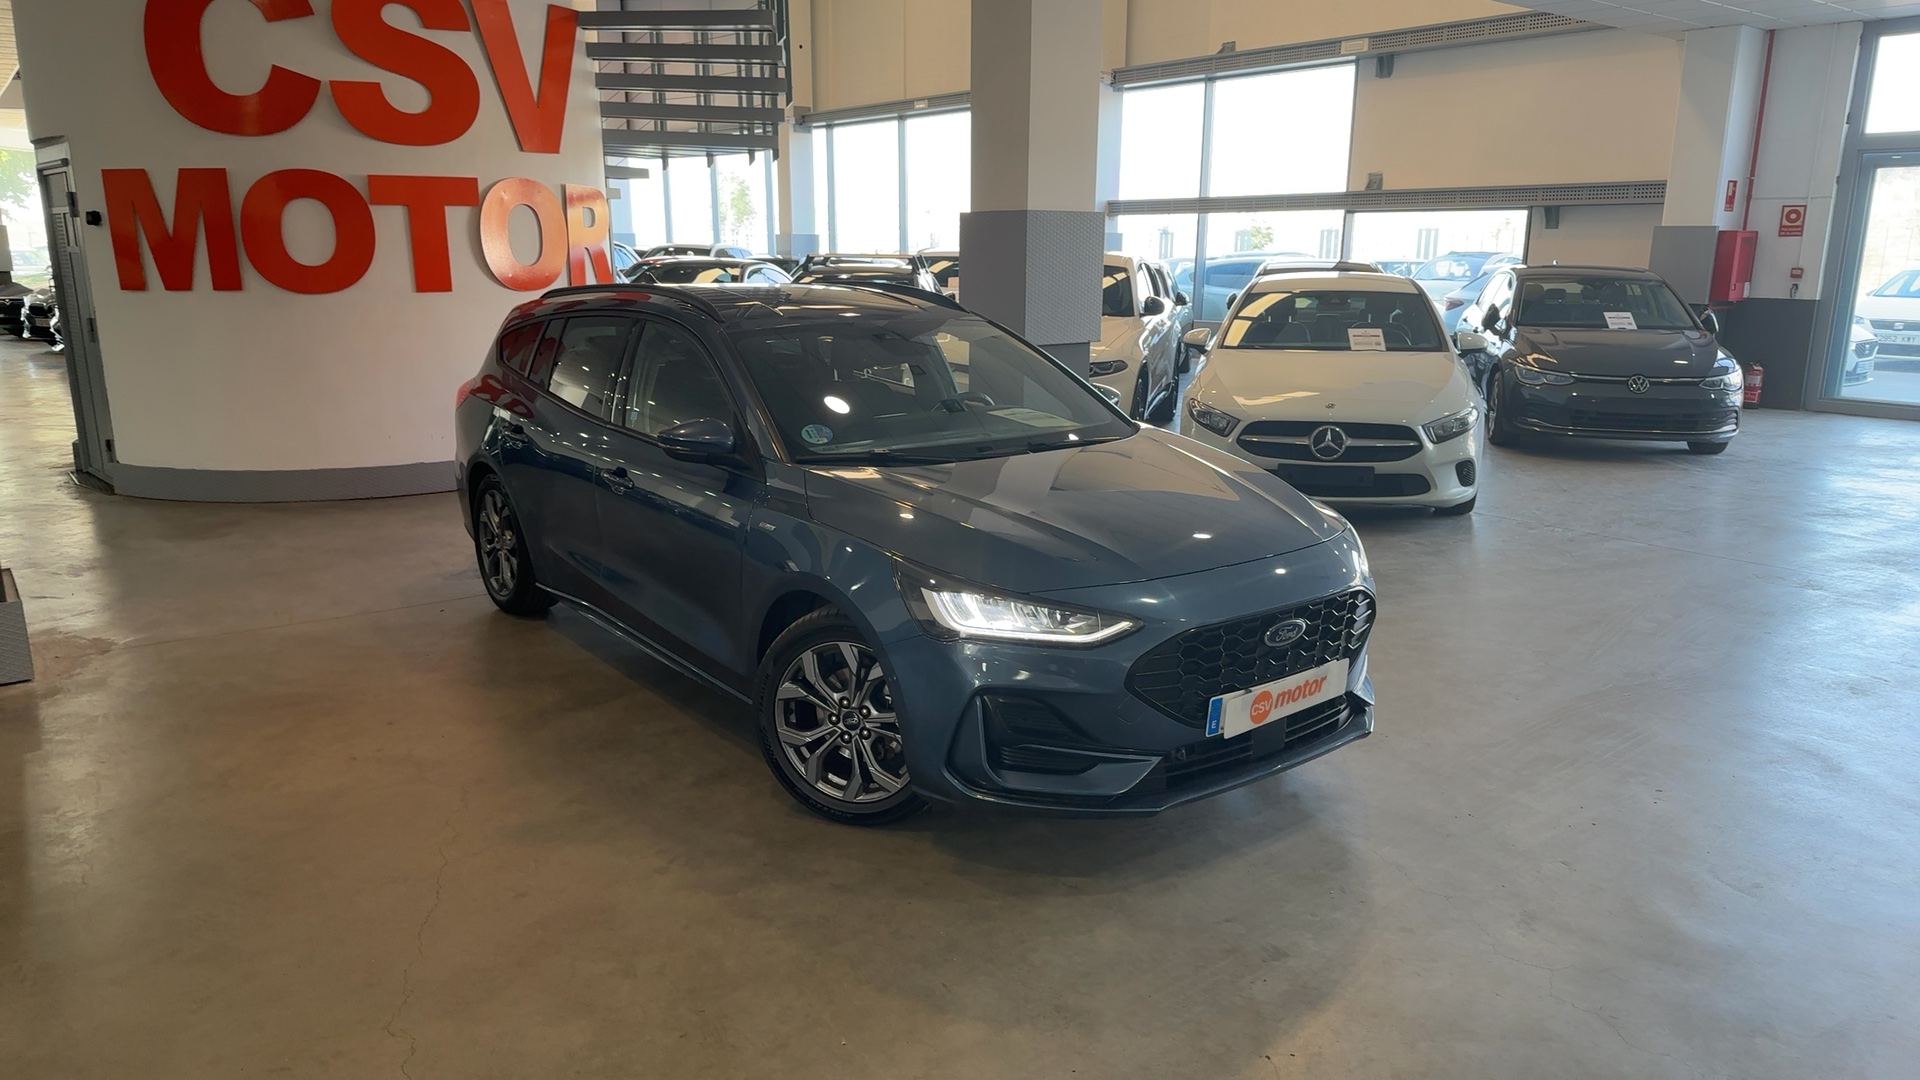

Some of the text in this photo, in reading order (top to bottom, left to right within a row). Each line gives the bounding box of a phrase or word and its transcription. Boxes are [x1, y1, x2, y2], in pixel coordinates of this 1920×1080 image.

[143, 0, 580, 153] CSV
[101, 168, 614, 294] MOTOR
[1275, 625, 1298, 642] Ford
[1251, 675, 1327, 716] CSV motor
[1211, 720, 1217, 729] E
